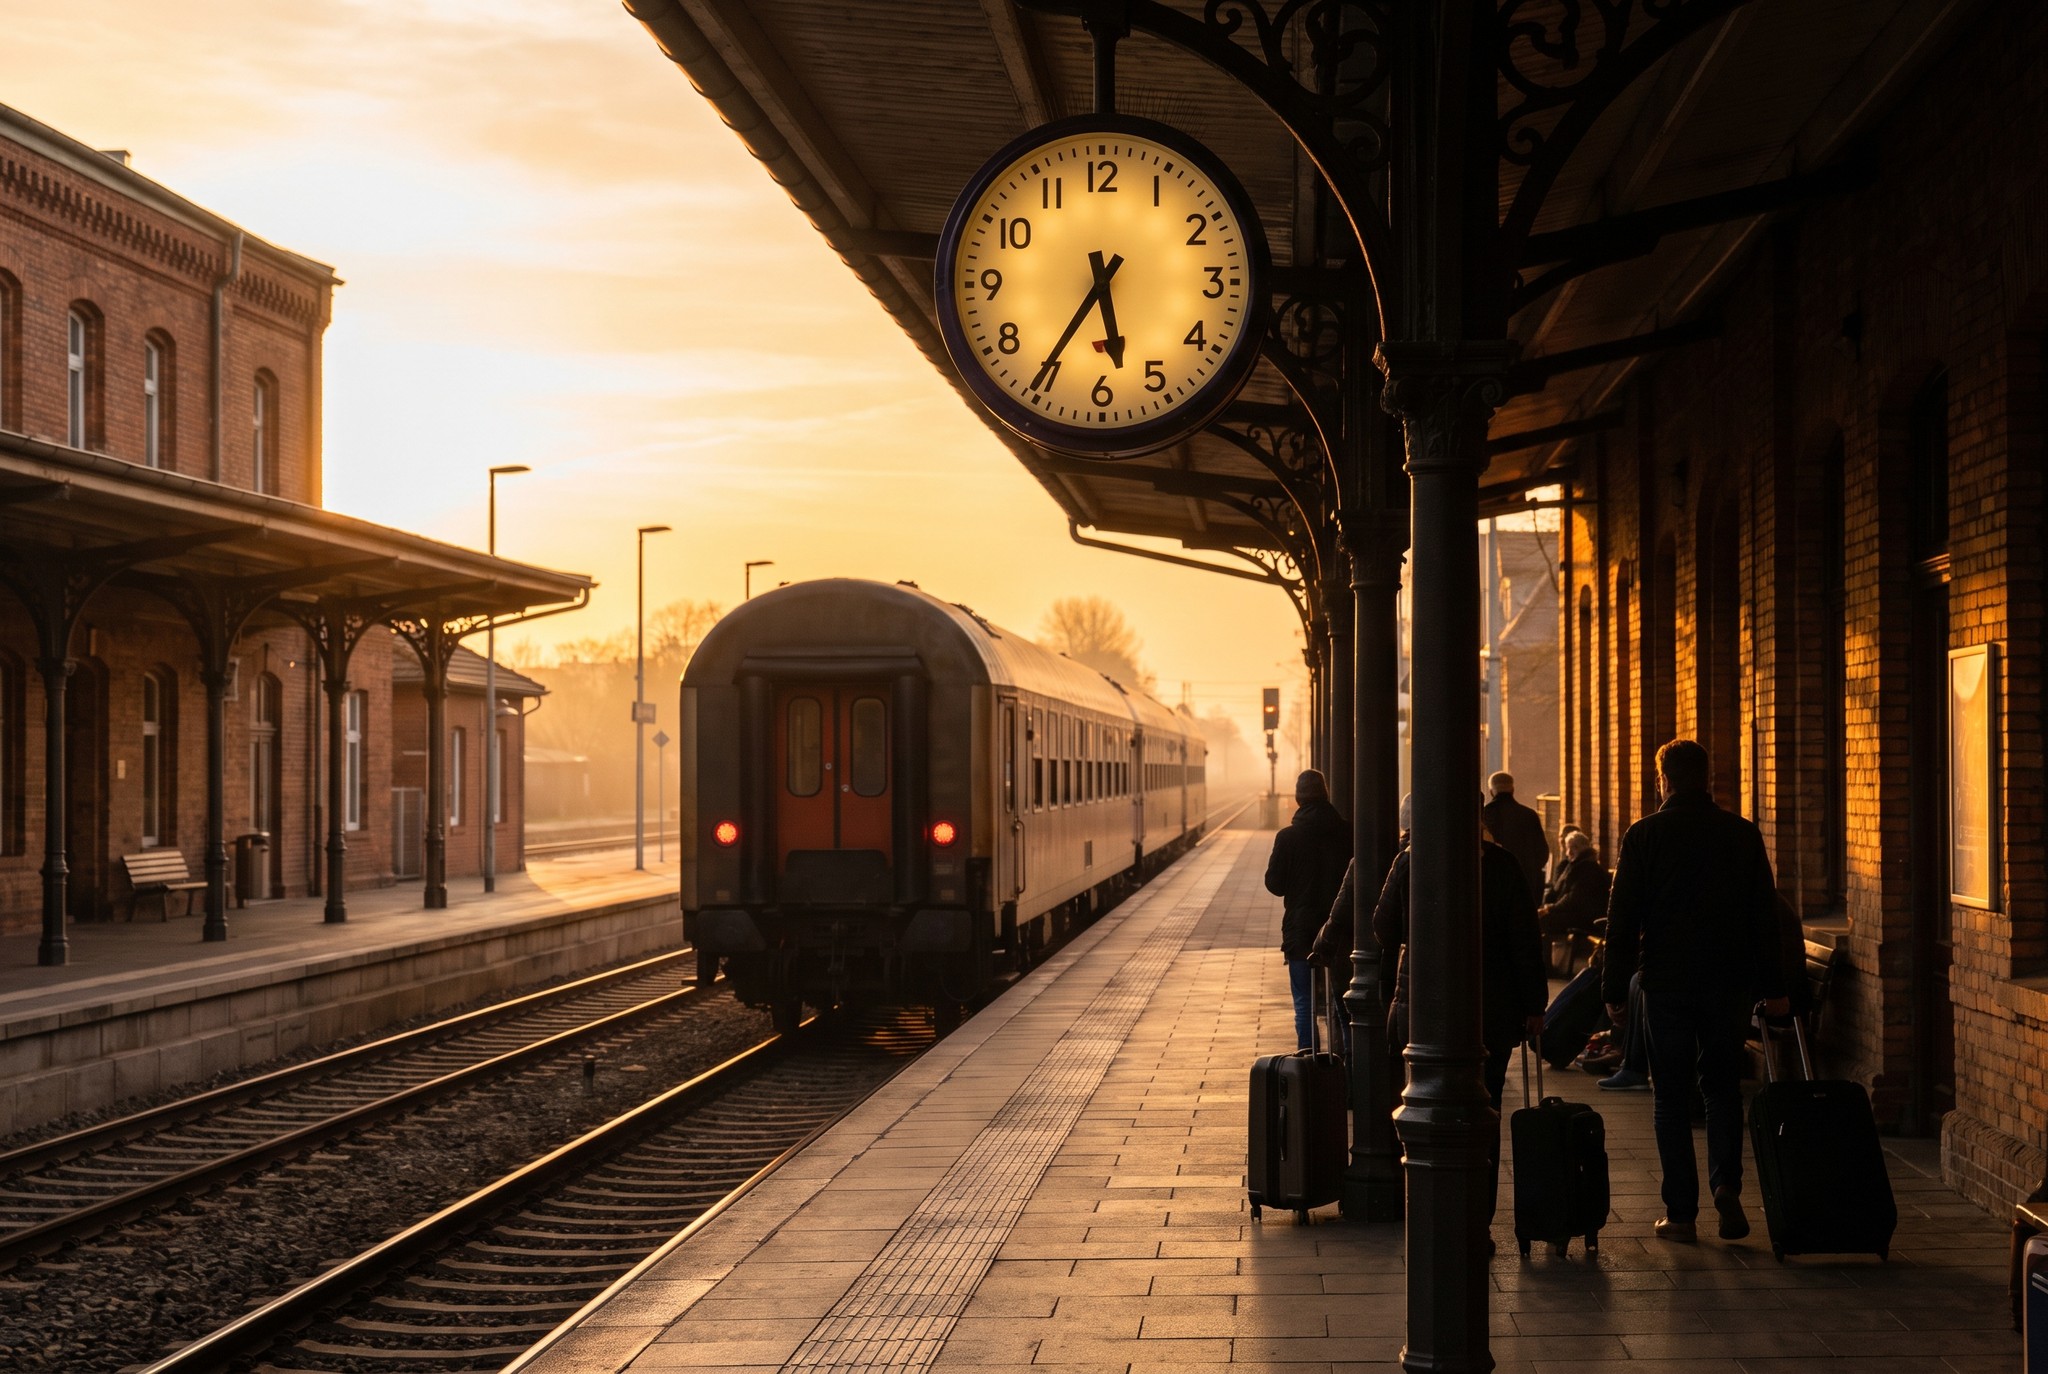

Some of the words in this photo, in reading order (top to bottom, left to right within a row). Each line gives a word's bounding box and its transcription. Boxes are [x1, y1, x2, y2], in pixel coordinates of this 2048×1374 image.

[1042, 177, 1062, 209] 11
[1087, 160, 1118, 193] 12
[1153, 175, 1160, 207] 1
[1000, 217, 1031, 249] 10
[1185, 213, 1207, 246] 2
[980, 268, 1003, 301] 9
[1202, 266, 1225, 299] 3
[997, 322, 1021, 355] 8
[1183, 320, 1207, 352] 4
[1041, 361, 1062, 392] 7
[1091, 375, 1114, 408] 6
[1144, 360, 1167, 393] 5
